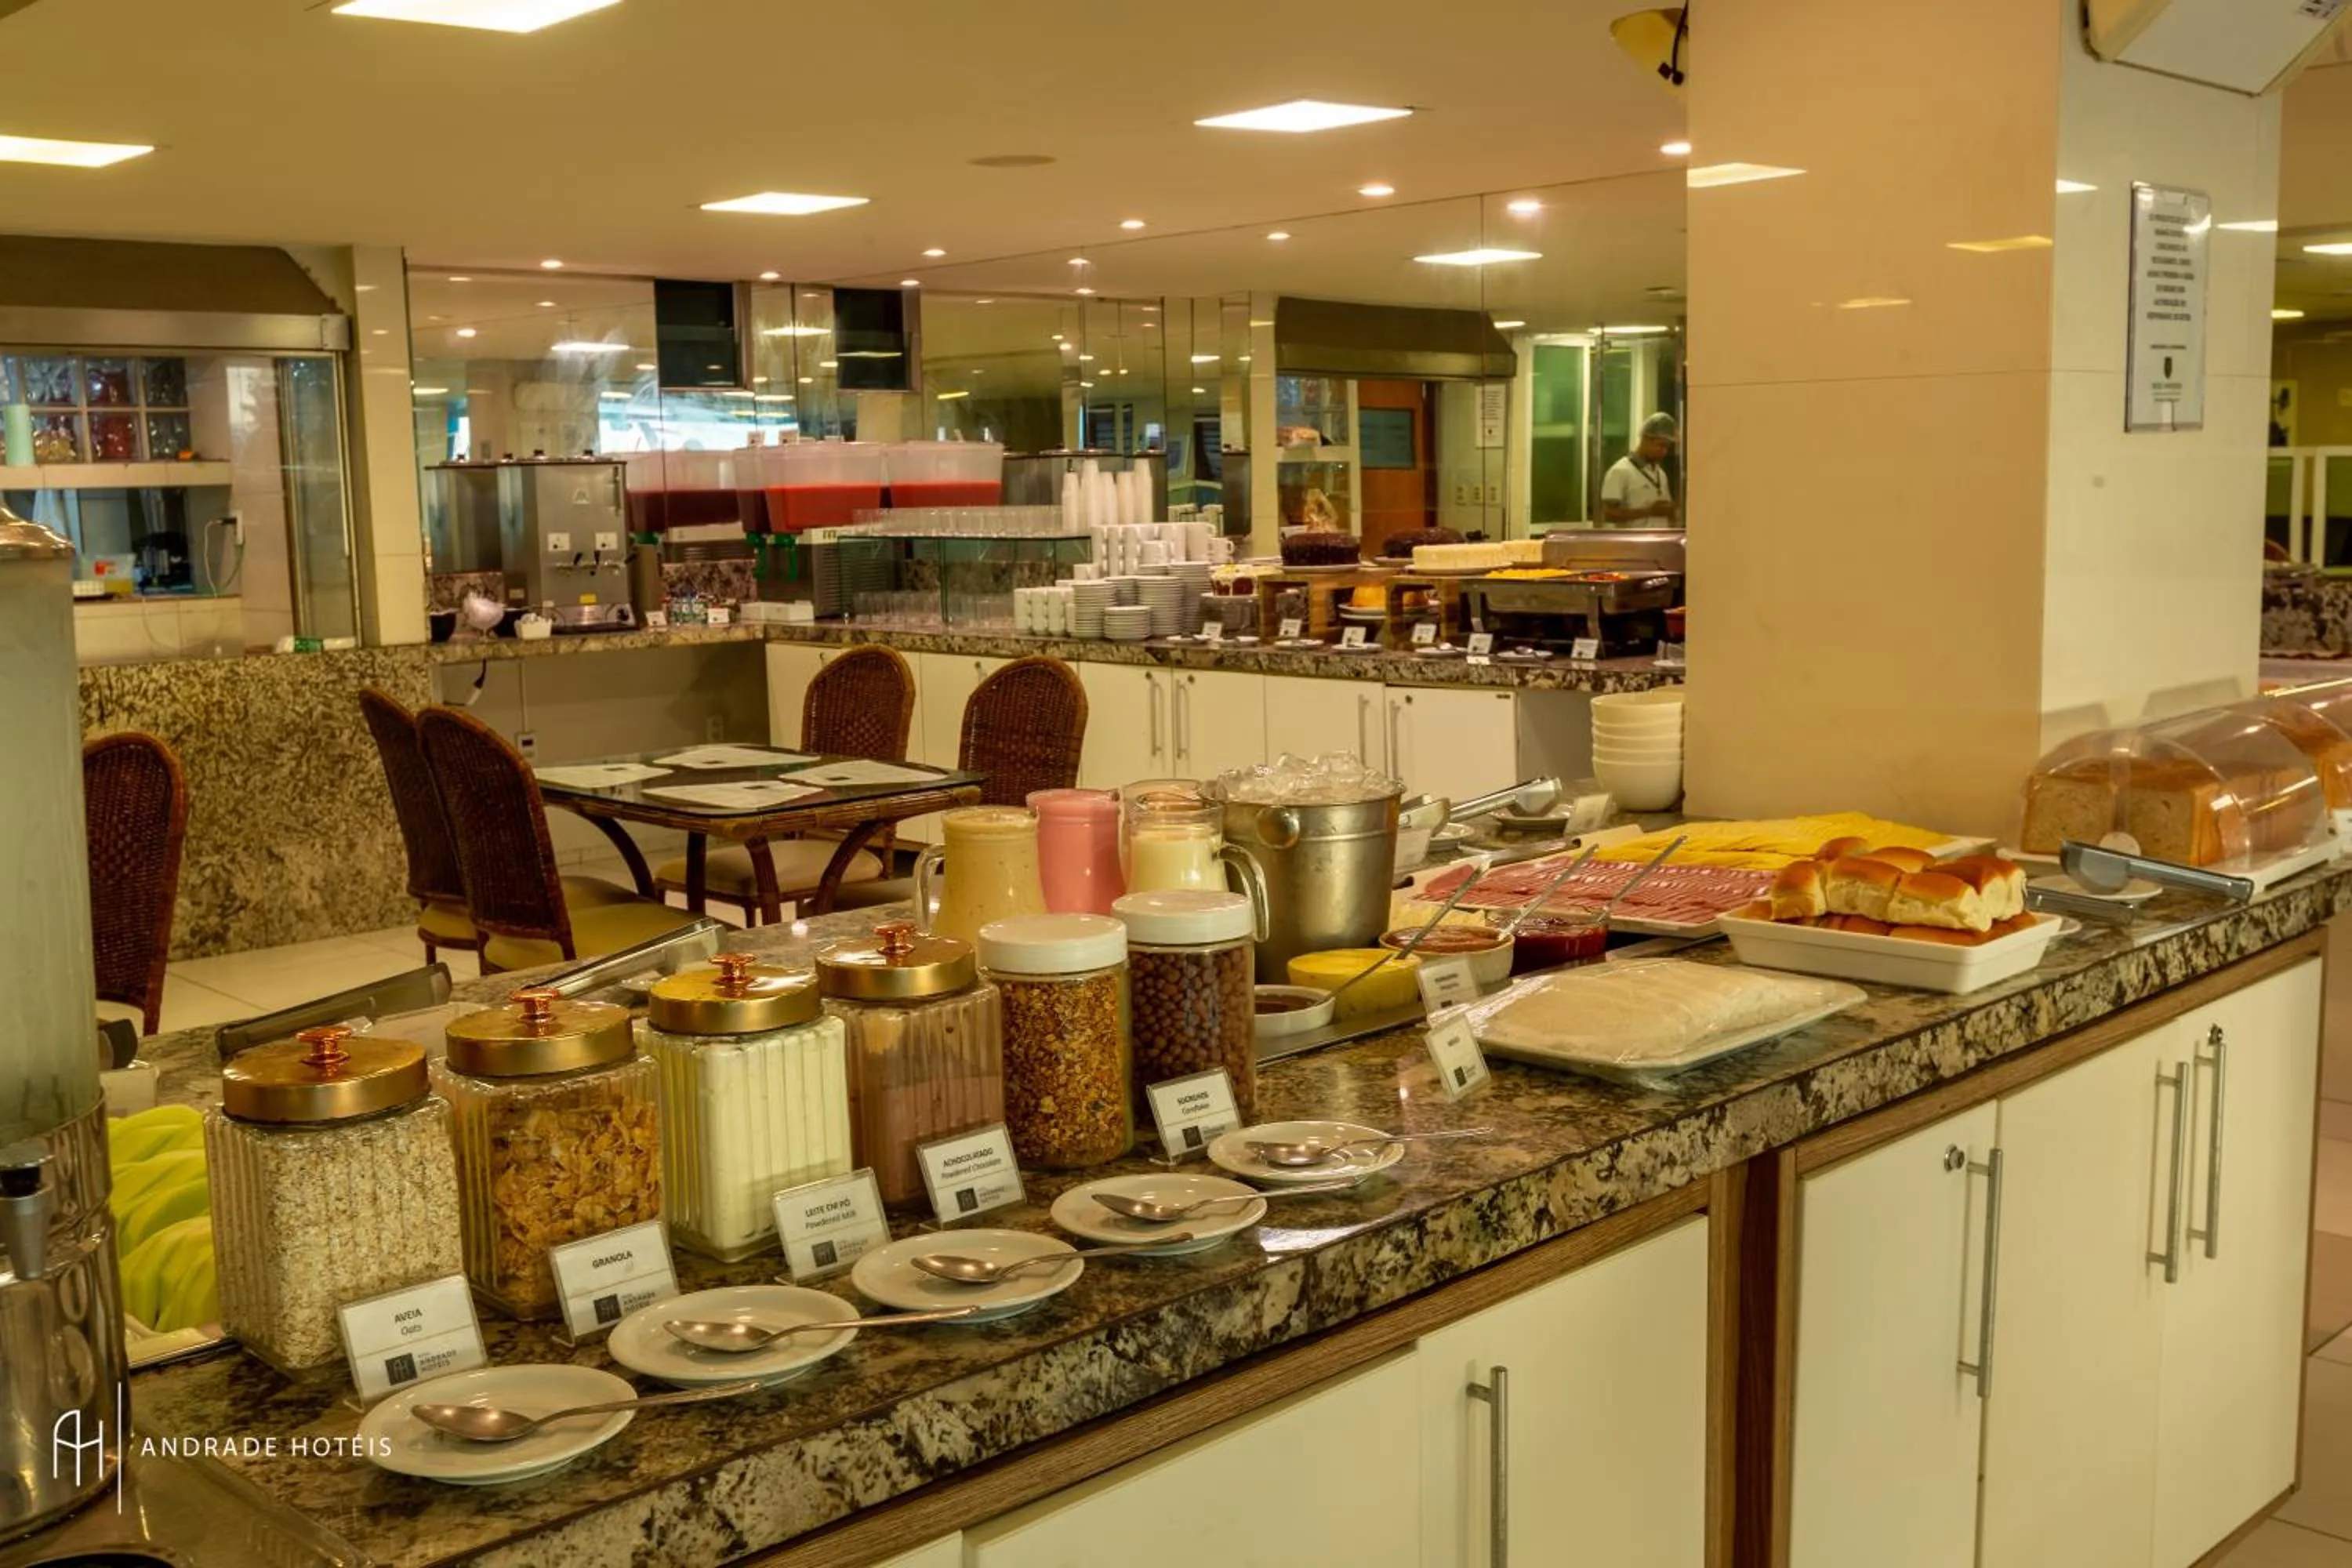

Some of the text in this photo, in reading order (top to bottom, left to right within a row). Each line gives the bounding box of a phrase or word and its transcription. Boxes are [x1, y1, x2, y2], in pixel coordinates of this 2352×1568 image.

[804, 1205, 825, 1218] LEITE
[592, 1250, 633, 1269] GRANOLA
[394, 1308, 423, 1323] AVEIA
[401, 1323, 423, 1336] Oats
